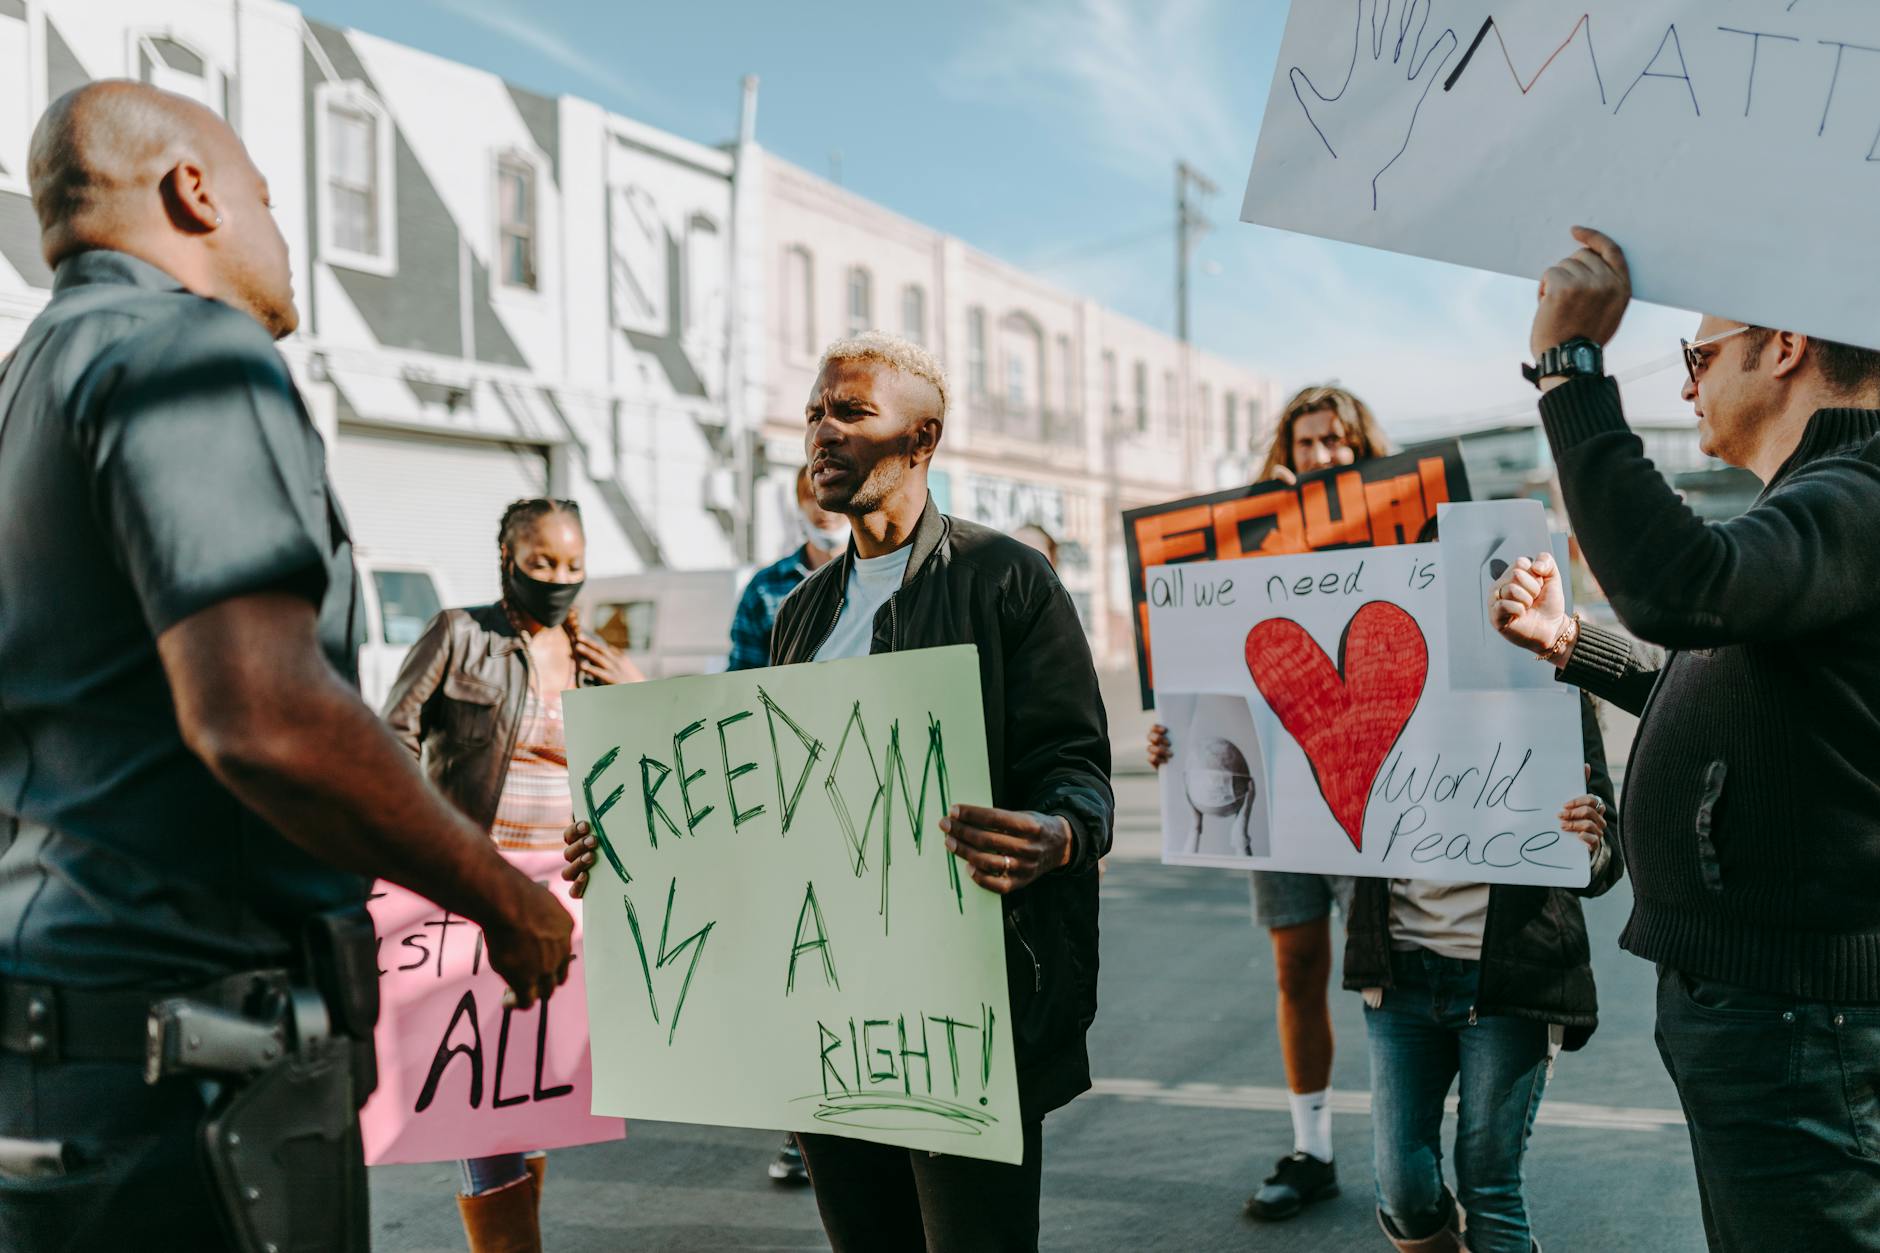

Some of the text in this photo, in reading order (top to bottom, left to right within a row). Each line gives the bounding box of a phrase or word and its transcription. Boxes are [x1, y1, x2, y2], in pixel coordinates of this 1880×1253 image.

[1443, 13, 1880, 162] MATT
[1151, 558, 1437, 608] all we need is
[583, 684, 963, 937] FREEDOM
[1375, 742, 1542, 813] World
[1382, 805, 1574, 871] Peace
[786, 880, 840, 997] A
[415, 990, 574, 1113] ALL
[817, 1002, 996, 1107] RIGHT!
